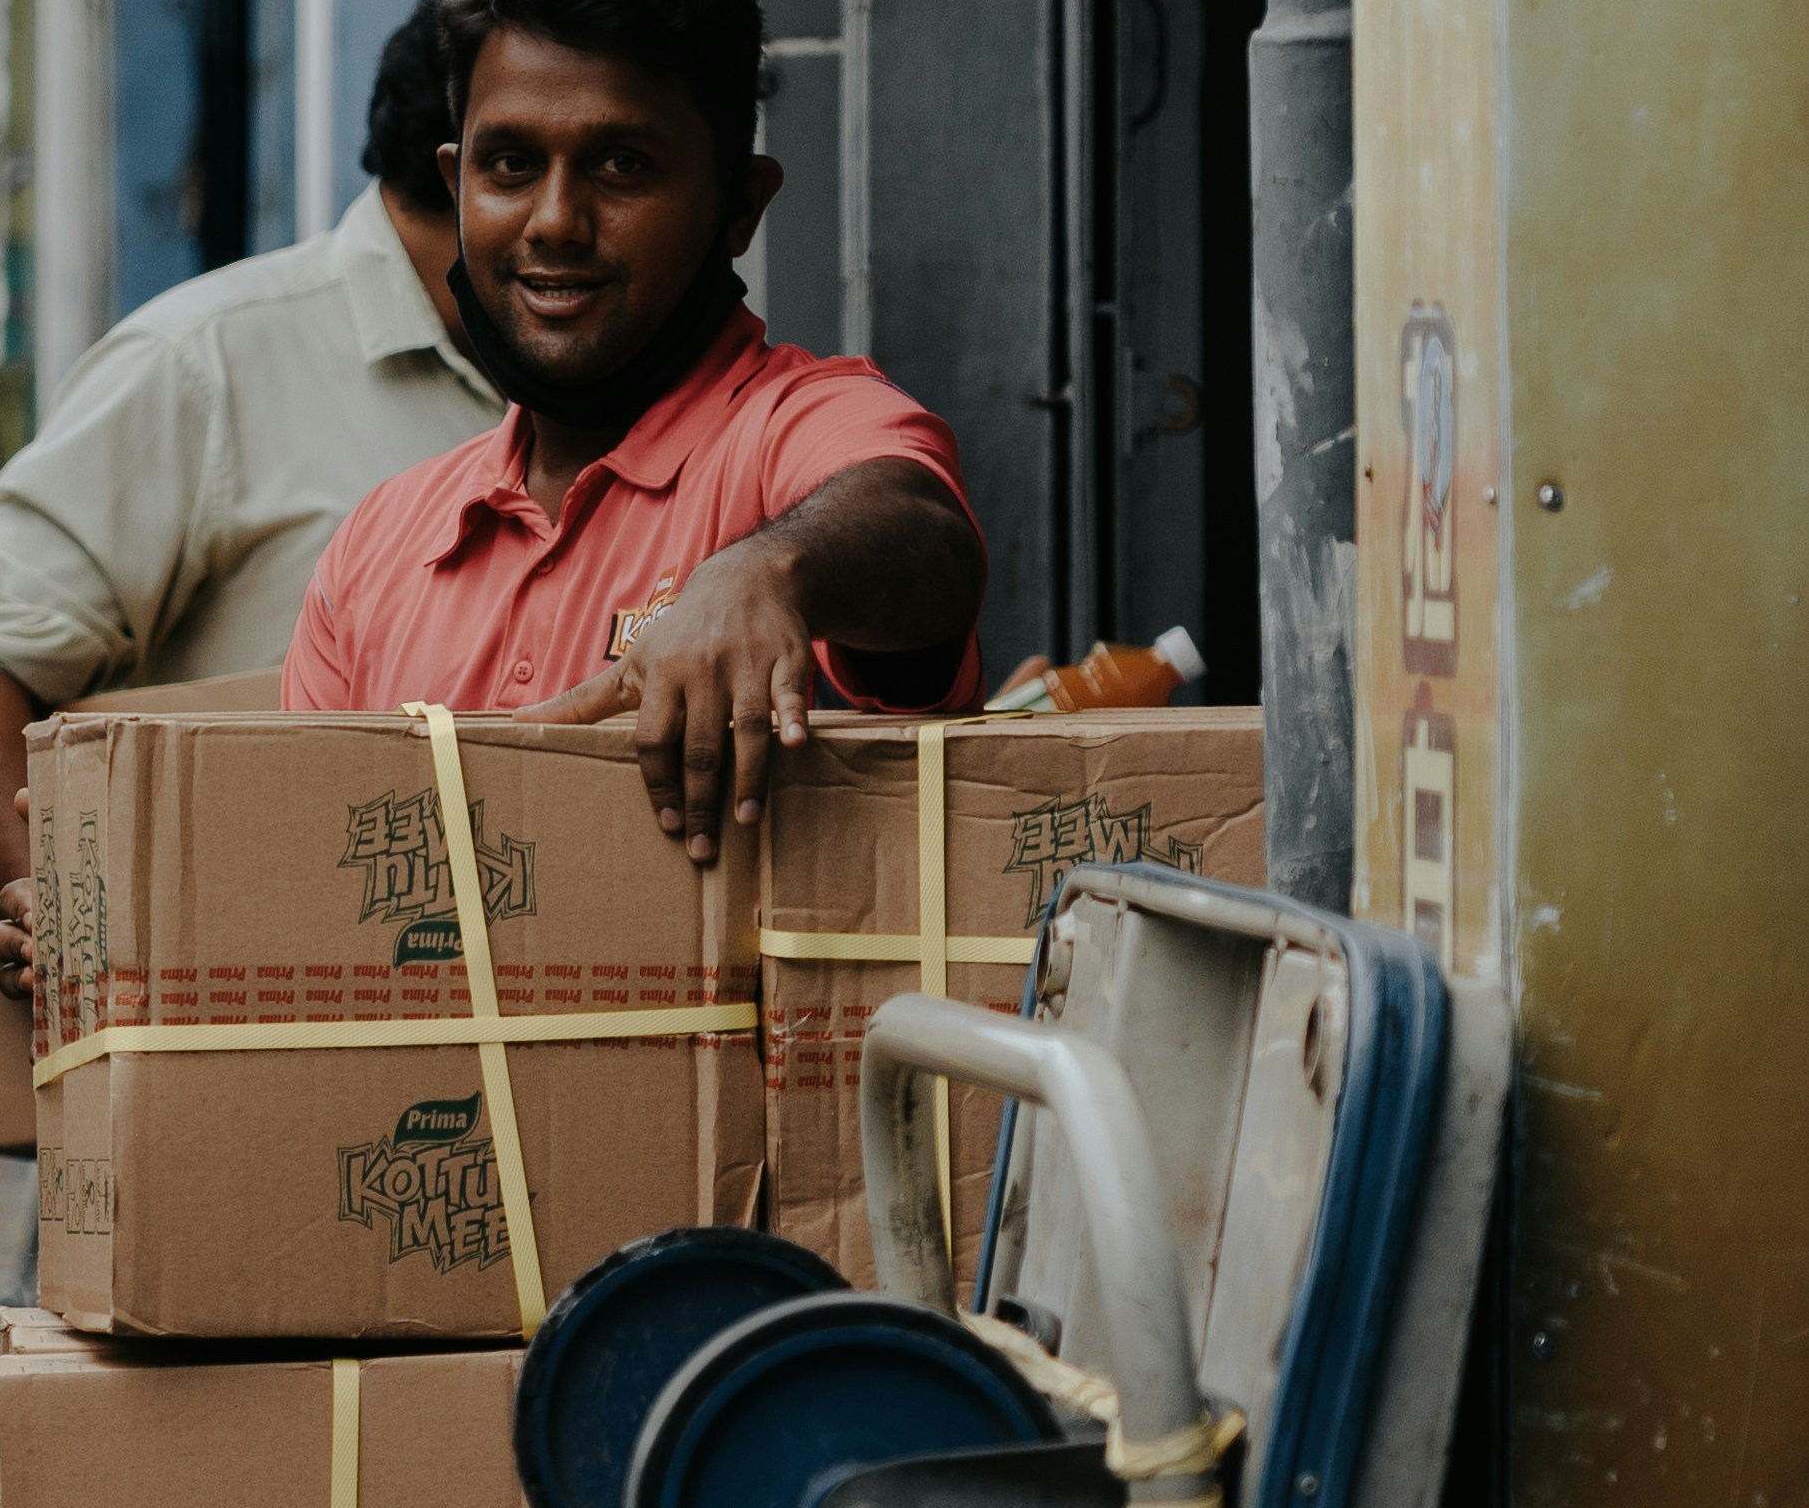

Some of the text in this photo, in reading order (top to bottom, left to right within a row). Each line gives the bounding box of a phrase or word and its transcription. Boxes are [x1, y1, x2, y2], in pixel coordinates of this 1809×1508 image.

[161, 969, 197, 982] Prima
[209, 968, 245, 981] Prima
[257, 967, 294, 980] Prima
[306, 966, 342, 979] Prima
[354, 966, 390, 979] Prima
[402, 966, 438, 978] Prima
[497, 965, 533, 979] Prima
[545, 966, 581, 979] Prima
[592, 966, 628, 980] Prima
[640, 966, 675, 980] Prima
[162, 993, 198, 1006] Prima
[210, 992, 246, 1005] Prima
[258, 991, 294, 1004] Prima
[306, 990, 343, 1003] Prima
[354, 990, 391, 1003] Prima
[402, 989, 439, 1002] Prima
[498, 989, 534, 1003] Prima
[545, 989, 581, 1003] Prima
[593, 990, 628, 1004] Prima
[640, 990, 675, 1004] Prima
[843, 1006, 871, 1018] rima
[640, 1036, 676, 1049] Prima
[797, 1051, 833, 1065] Prima
[797, 1075, 834, 1089] Prima
[405, 1109, 468, 1130] Prima
